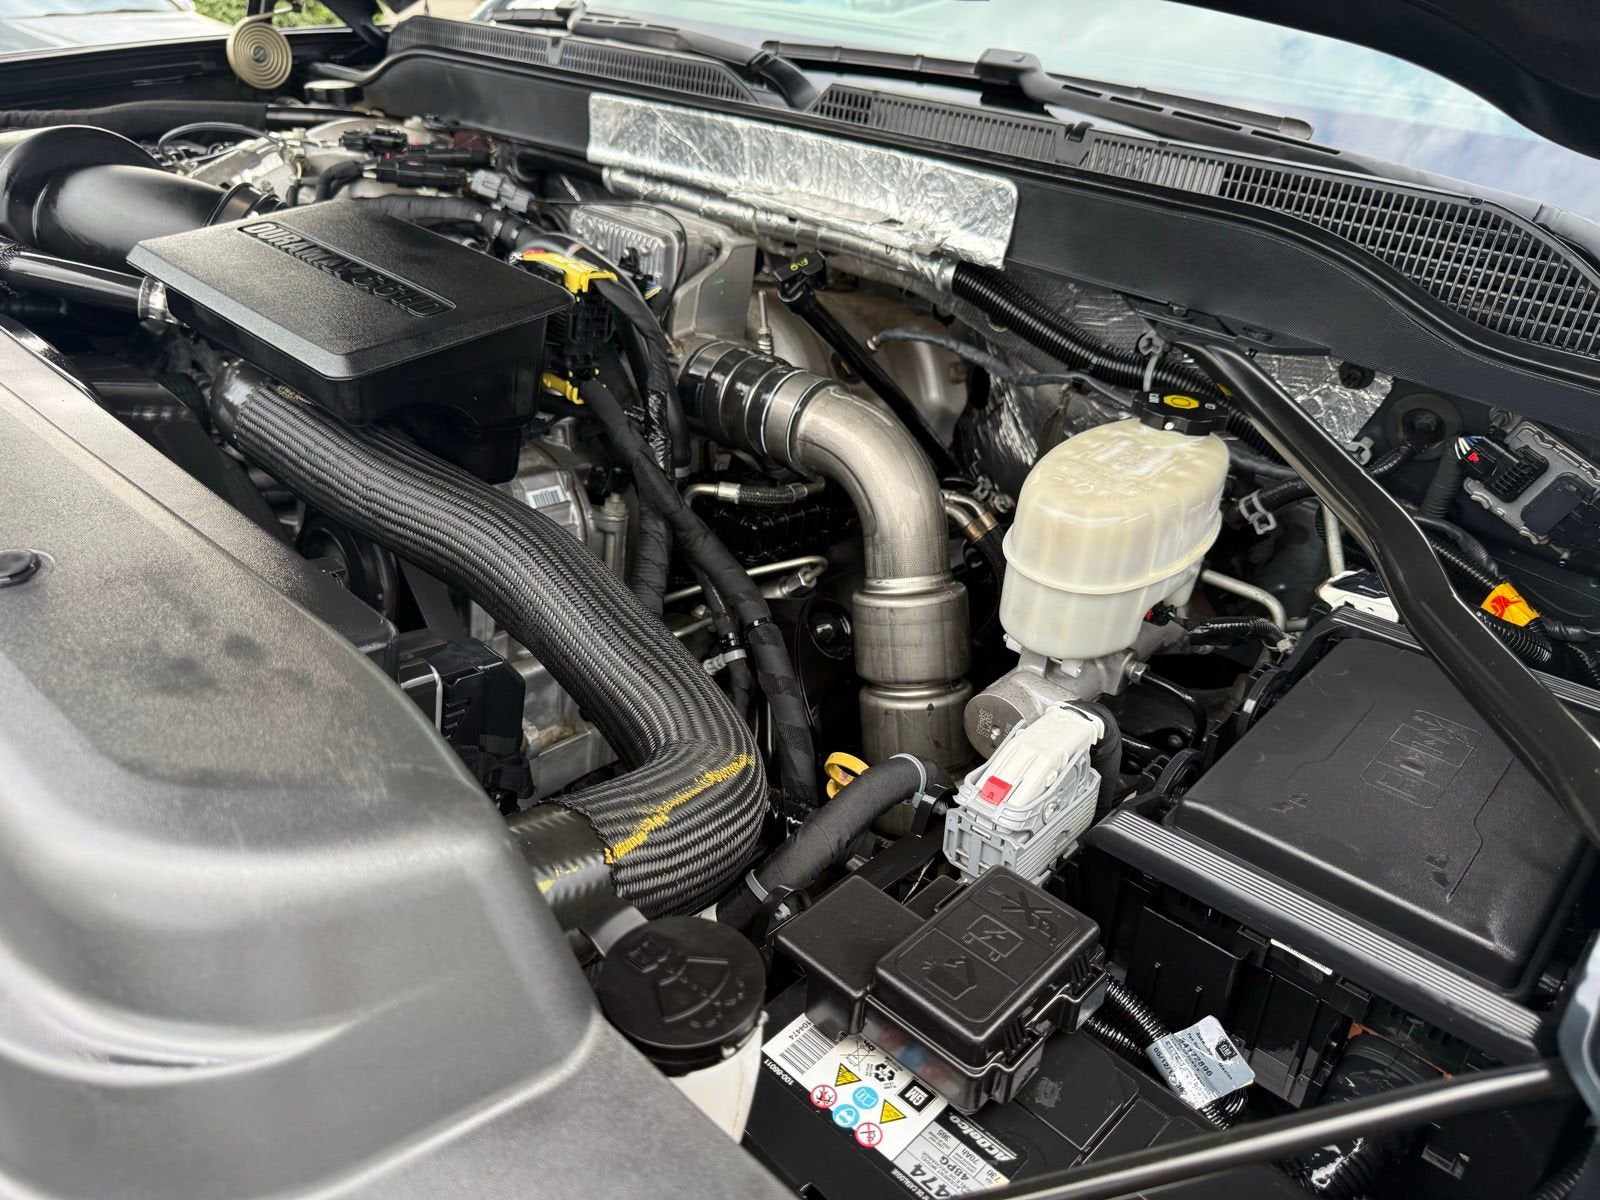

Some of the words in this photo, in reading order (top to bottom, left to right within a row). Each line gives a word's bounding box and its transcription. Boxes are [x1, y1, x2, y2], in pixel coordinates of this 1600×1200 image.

[904, 1085, 929, 1106] GM
[936, 1128, 951, 1142] 365
[949, 1115, 1012, 1161] ACDelco
[960, 1147, 979, 1165] 70Ah
[939, 1155, 968, 1181] 48PG
